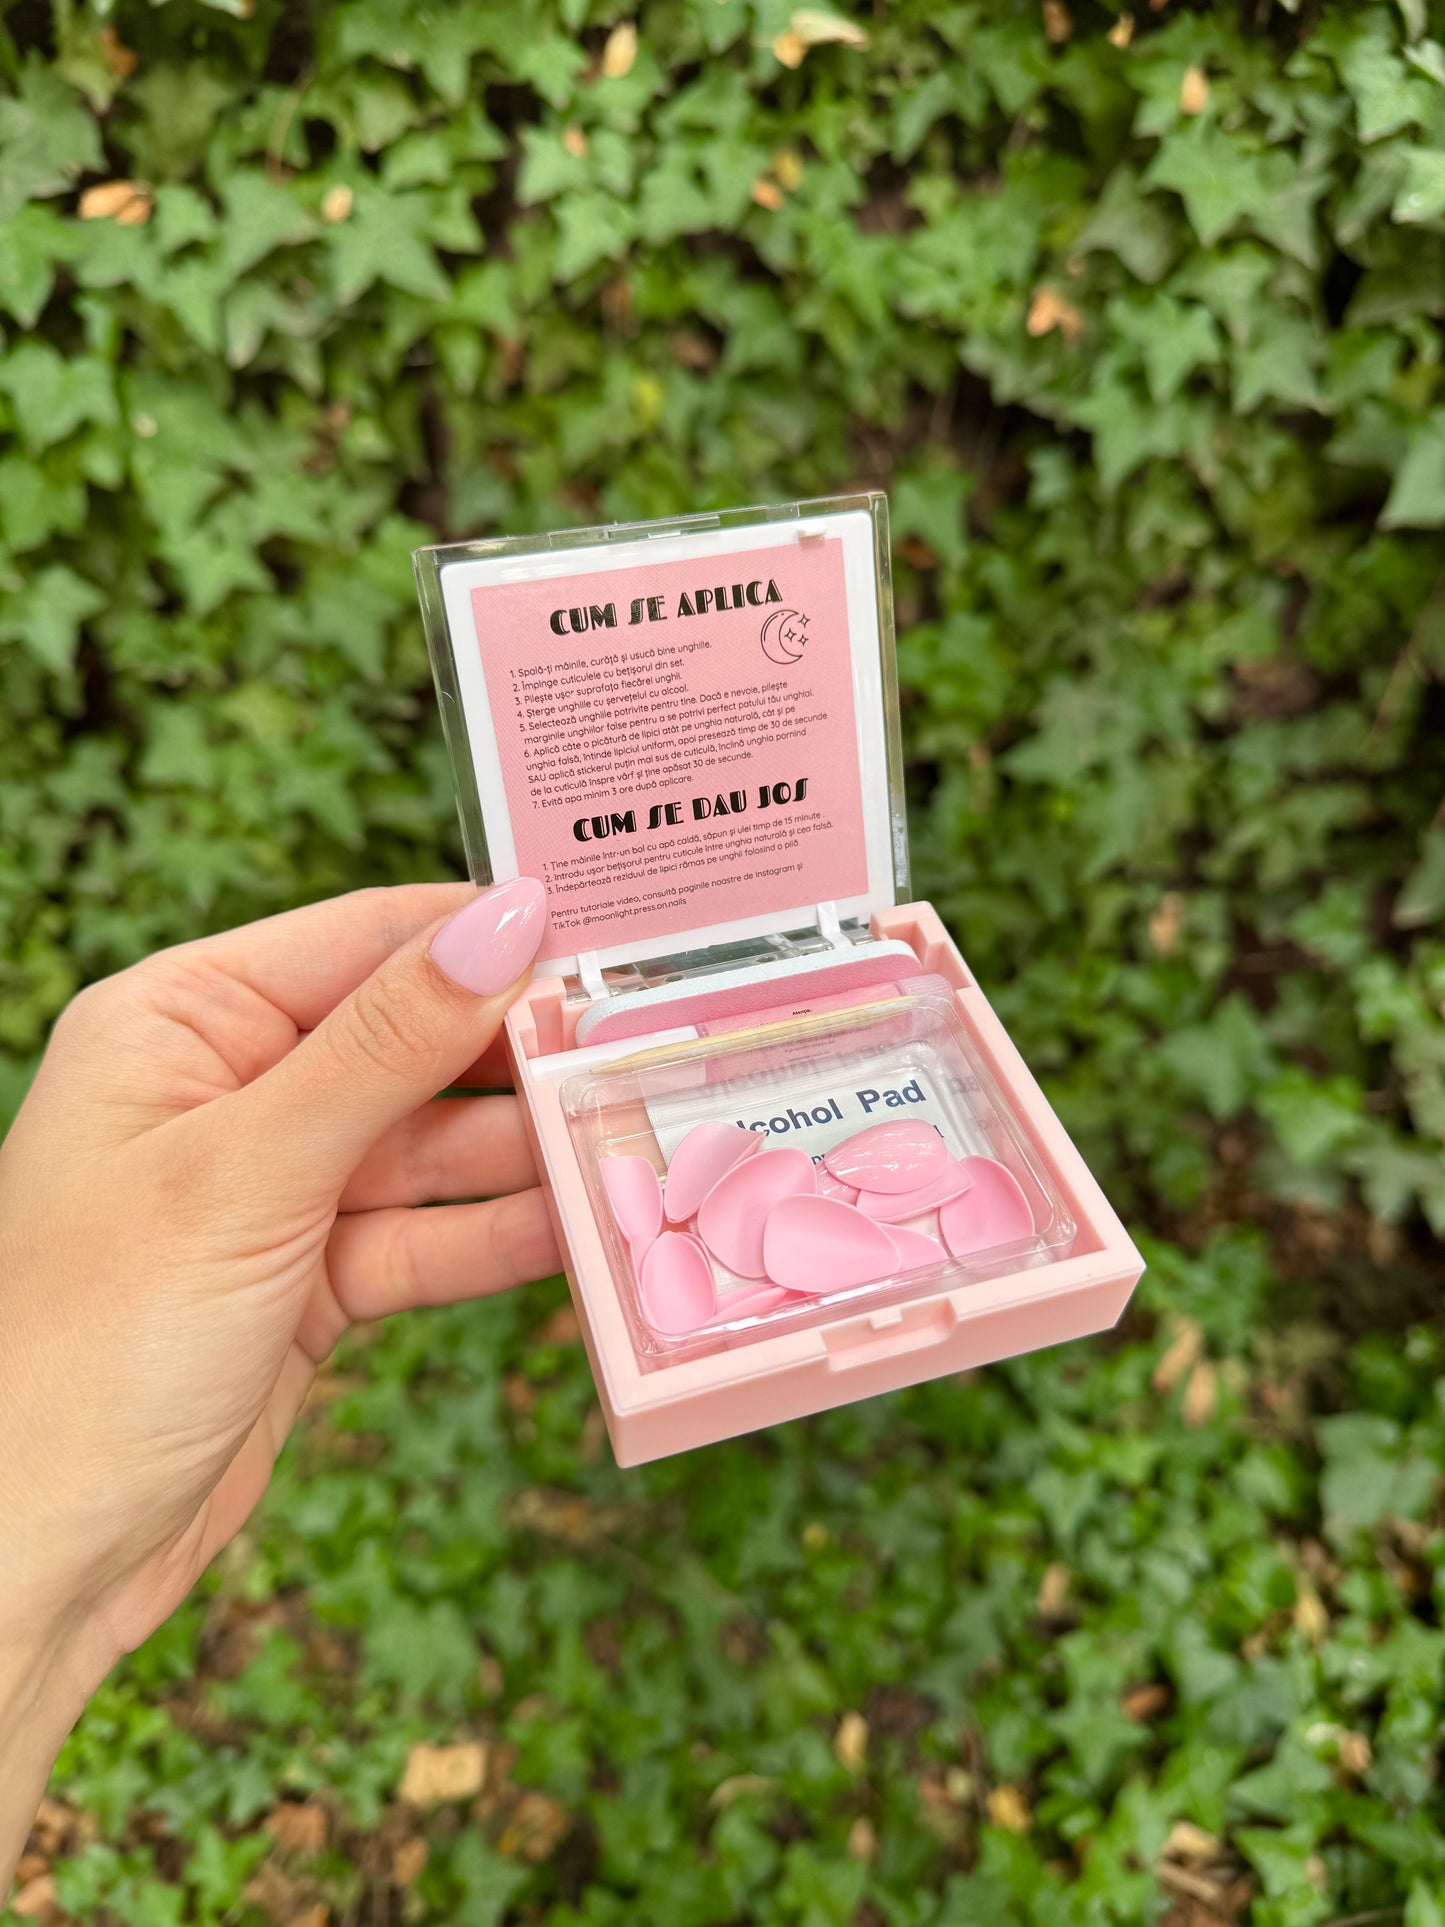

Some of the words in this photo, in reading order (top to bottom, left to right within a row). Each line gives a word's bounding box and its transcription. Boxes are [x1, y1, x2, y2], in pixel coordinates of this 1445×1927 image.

[550, 603, 617, 635] CUM
[628, 596, 667, 625] SE
[677, 579, 783, 618] APLICA
[510, 670, 516, 678] 1.
[657, 646, 675, 656] bine
[678, 641, 712, 653] unghiile.
[512, 683, 520, 692] 2.
[560, 671, 601, 685] cuticulele
[655, 661, 668, 670] din
[670, 659, 684, 668] set.
[514, 697, 522, 705] 3.
[655, 672, 682, 683] unghii.
[517, 711, 525, 719] 4.
[558, 700, 591, 712] unghiile
[649, 690, 659, 698] cu
[661, 684, 688, 695] alcool.
[520, 723, 527, 732] 5.
[579, 709, 612, 722] unghiile
[614, 705, 649, 718] potrivite
[651, 700, 678, 712] pentru
[680, 697, 698, 706] tine.
[731, 686, 760, 697] nevoie,
[524, 731, 565, 744] marginile
[568, 725, 604, 737] unghiilor
[606, 722, 627, 731] false
[629, 717, 657, 729] pentru
[679, 708, 705, 721] potrivi
[707, 703, 736, 716] perfect
[738, 697, 766, 711] patului
[783, 688, 814, 701] unghial.
[524, 749, 531, 758] 6.
[629, 732, 640, 741] de
[642, 728, 660, 739] lipici
[682, 724, 692, 733] pe
[694, 719, 722, 729] unghia
[785, 706, 795, 715] pe
[526, 759, 556, 771] unghia
[614, 744, 639, 757] lipiciul
[642, 740, 676, 751] uniform,
[678, 735, 696, 745] apoi
[738, 726, 756, 734] timp
[758, 723, 768, 731] de
[770, 720, 780, 729] 30
[782, 719, 792, 727] de
[794, 712, 827, 724] secunde
[528, 773, 546, 783] SAU
[577, 762, 612, 775] stickerul
[637, 755, 653, 765] mai
[655, 754, 669, 762] sus
[671, 751, 681, 759] de
[746, 735, 774, 745] unghia
[776, 728, 806, 742] pornind
[530, 788, 542, 796] de
[543, 786, 552, 794] la
[693, 759, 703, 768] 30
[705, 757, 716, 766] de
[718, 751, 753, 763] secunde.
[532, 801, 540, 809] 7.
[565, 795, 582, 804] apa
[584, 790, 610, 800] minim
[611, 787, 617, 795] 3
[619, 786, 633, 794] ore
[659, 776, 694, 788] aplicare.
[573, 810, 637, 842] CUM
[647, 802, 684, 829] SE
[692, 790, 747, 820] DAU
[757, 778, 808, 809] JOS
[542, 863, 549, 871] 1.
[632, 844, 645, 854] bol
[737, 825, 751, 834] ulei
[753, 822, 771, 831] timp
[772, 819, 782, 827] de
[784, 816, 792, 824] 15
[794, 813, 820, 822] minute
[545, 875, 552, 883] 2.
[554, 869, 584, 881] Introdu
[644, 854, 671, 865] pentru
[673, 846, 703, 858] cuticule
[725, 837, 752, 848] unghia
[547, 887, 554, 895] 3.
[613, 869, 645, 882] reziduul
[647, 867, 658, 875] de
[660, 863, 677, 874] lipici
[707, 857, 717, 865] pe
[719, 851, 742, 861] unghii
[745, 844, 775, 856] folosind
[551, 909, 578, 918] Pentru
[580, 901, 614, 913] tutoriale
[616, 896, 641, 905] video,
[678, 881, 709, 895] paginile
[711, 876, 742, 886] noastre
[743, 872, 753, 880] de
[755, 865, 795, 878] Instagram
[552, 919, 581, 930] TikTok
[736, 1098, 844, 1137] lcohol
[856, 1079, 926, 1113] Pad
